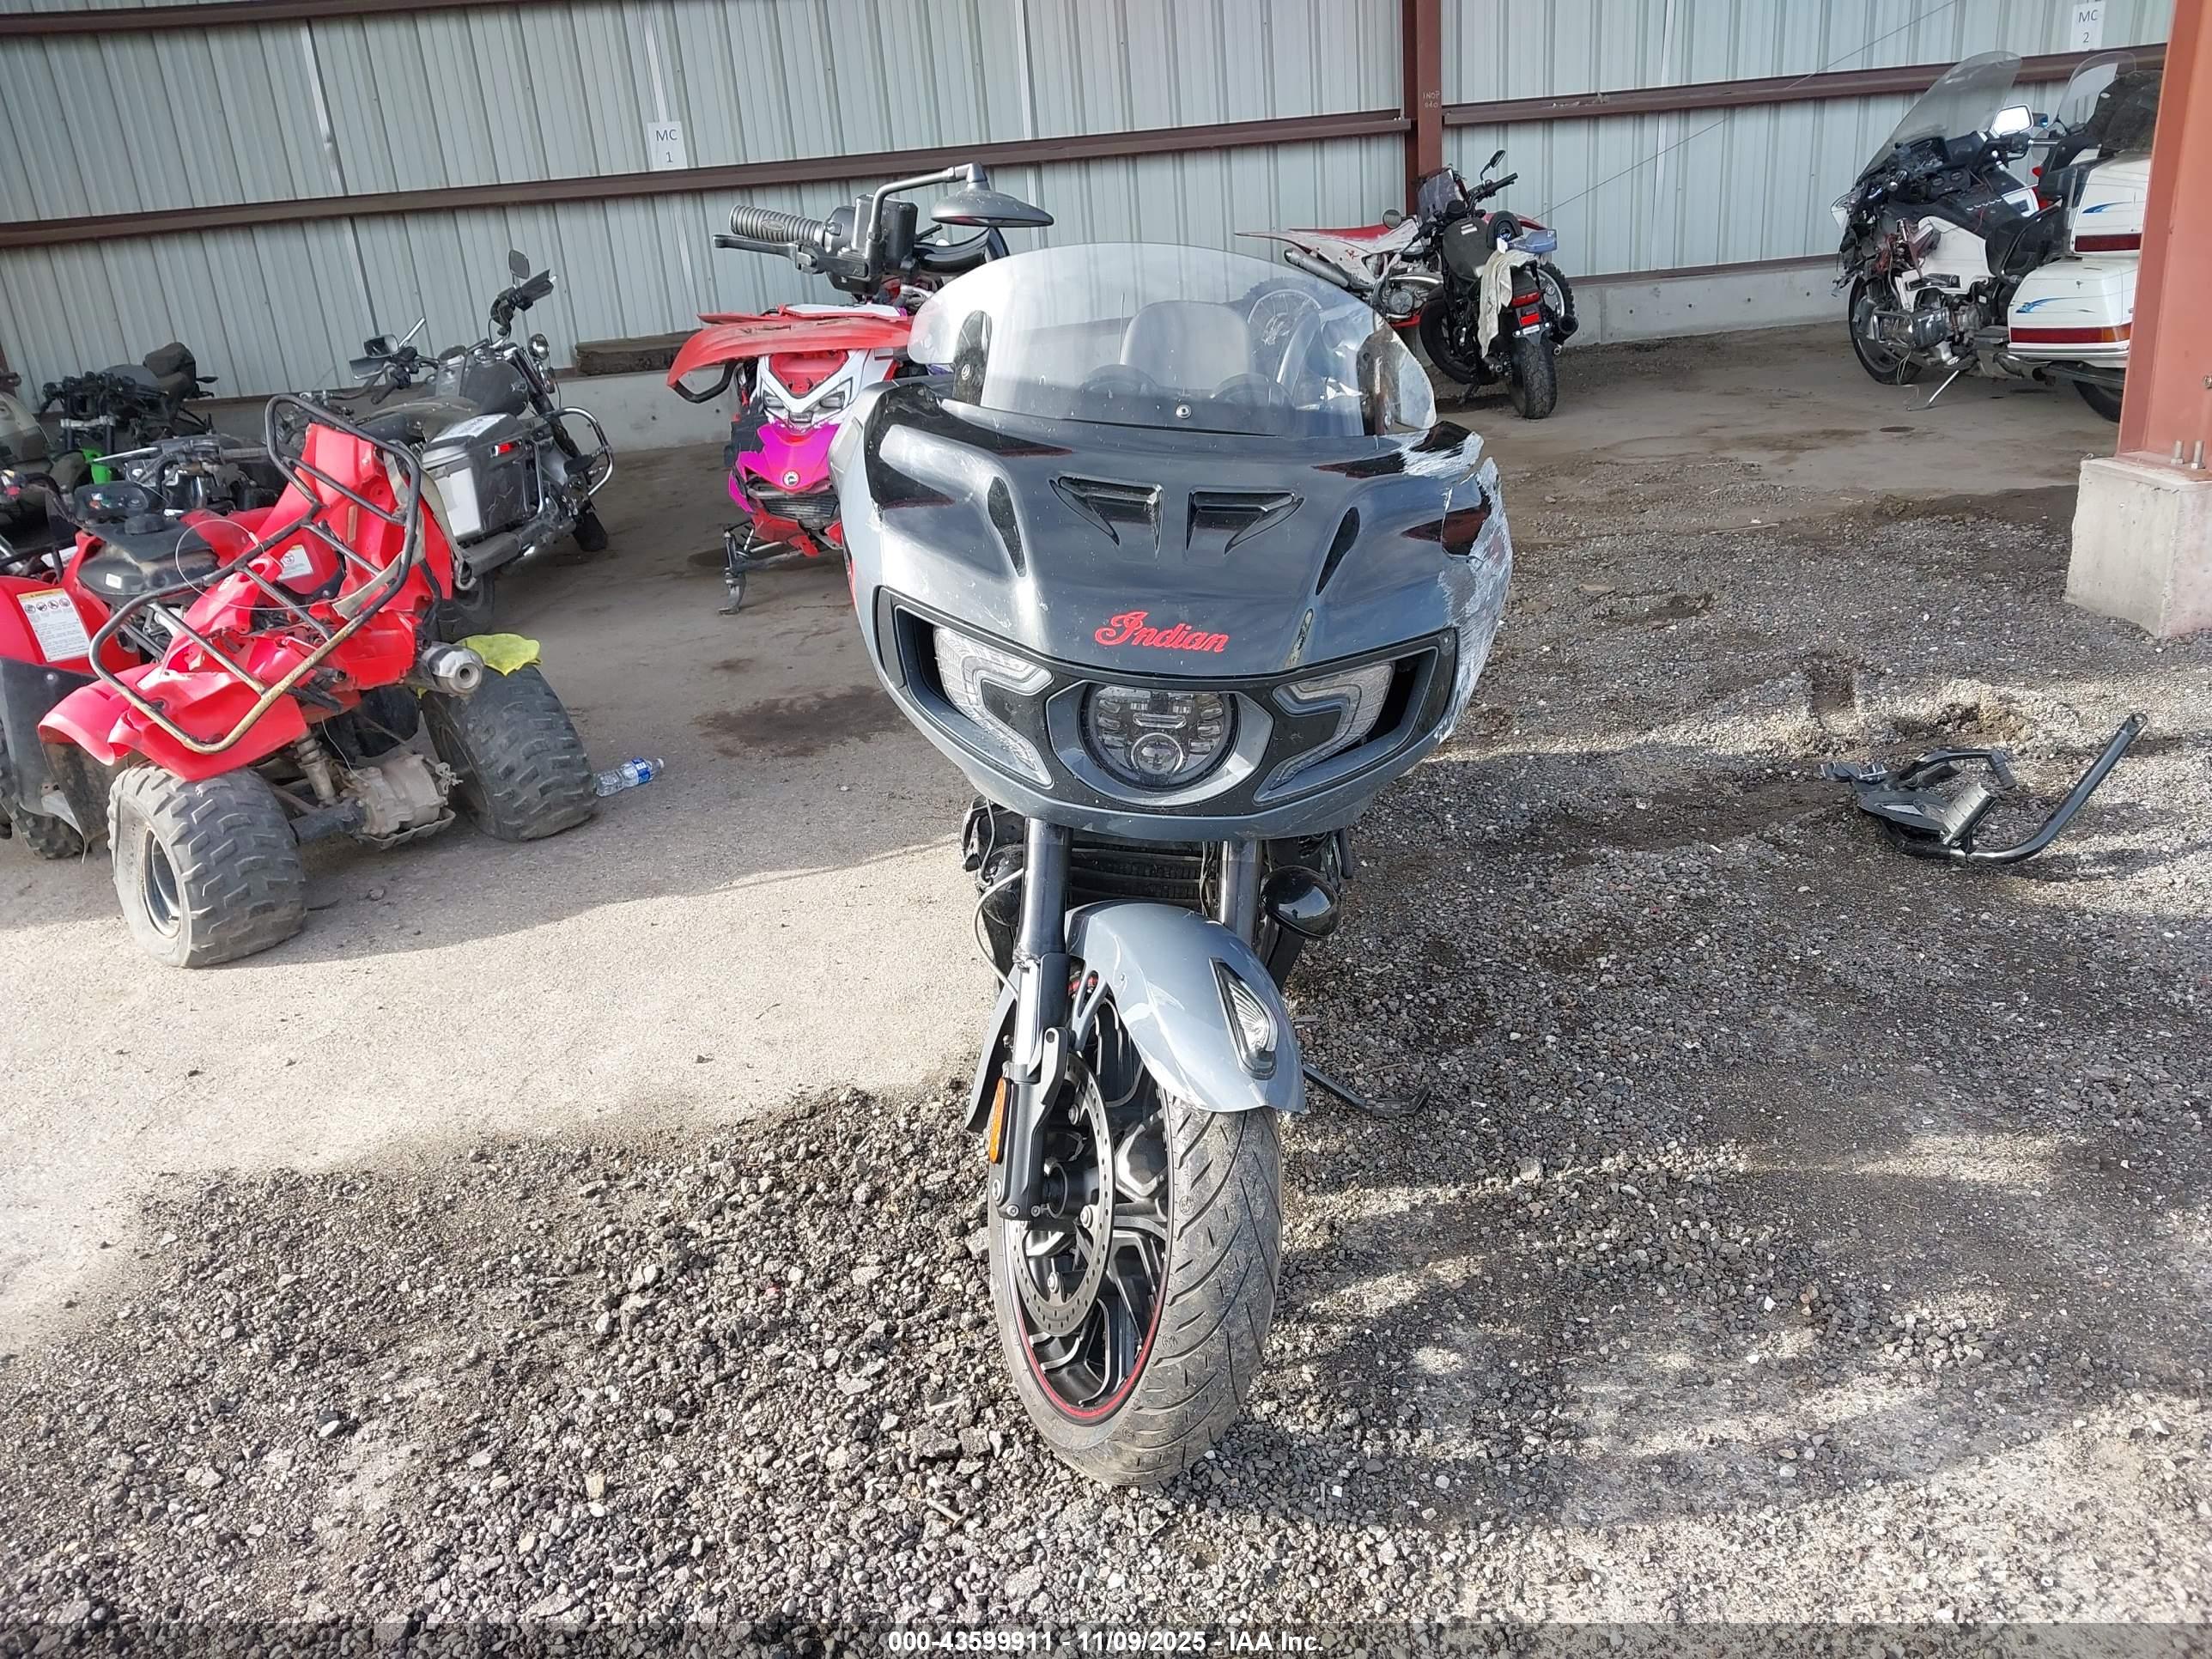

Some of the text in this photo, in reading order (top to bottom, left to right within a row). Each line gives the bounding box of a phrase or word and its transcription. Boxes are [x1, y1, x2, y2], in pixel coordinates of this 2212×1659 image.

[2078, 9, 2099, 23] MC
[2082, 31, 2089, 43] 2
[655, 128, 678, 142] MC
[665, 150, 673, 163] 1
[1094, 611, 1230, 653] Indian
